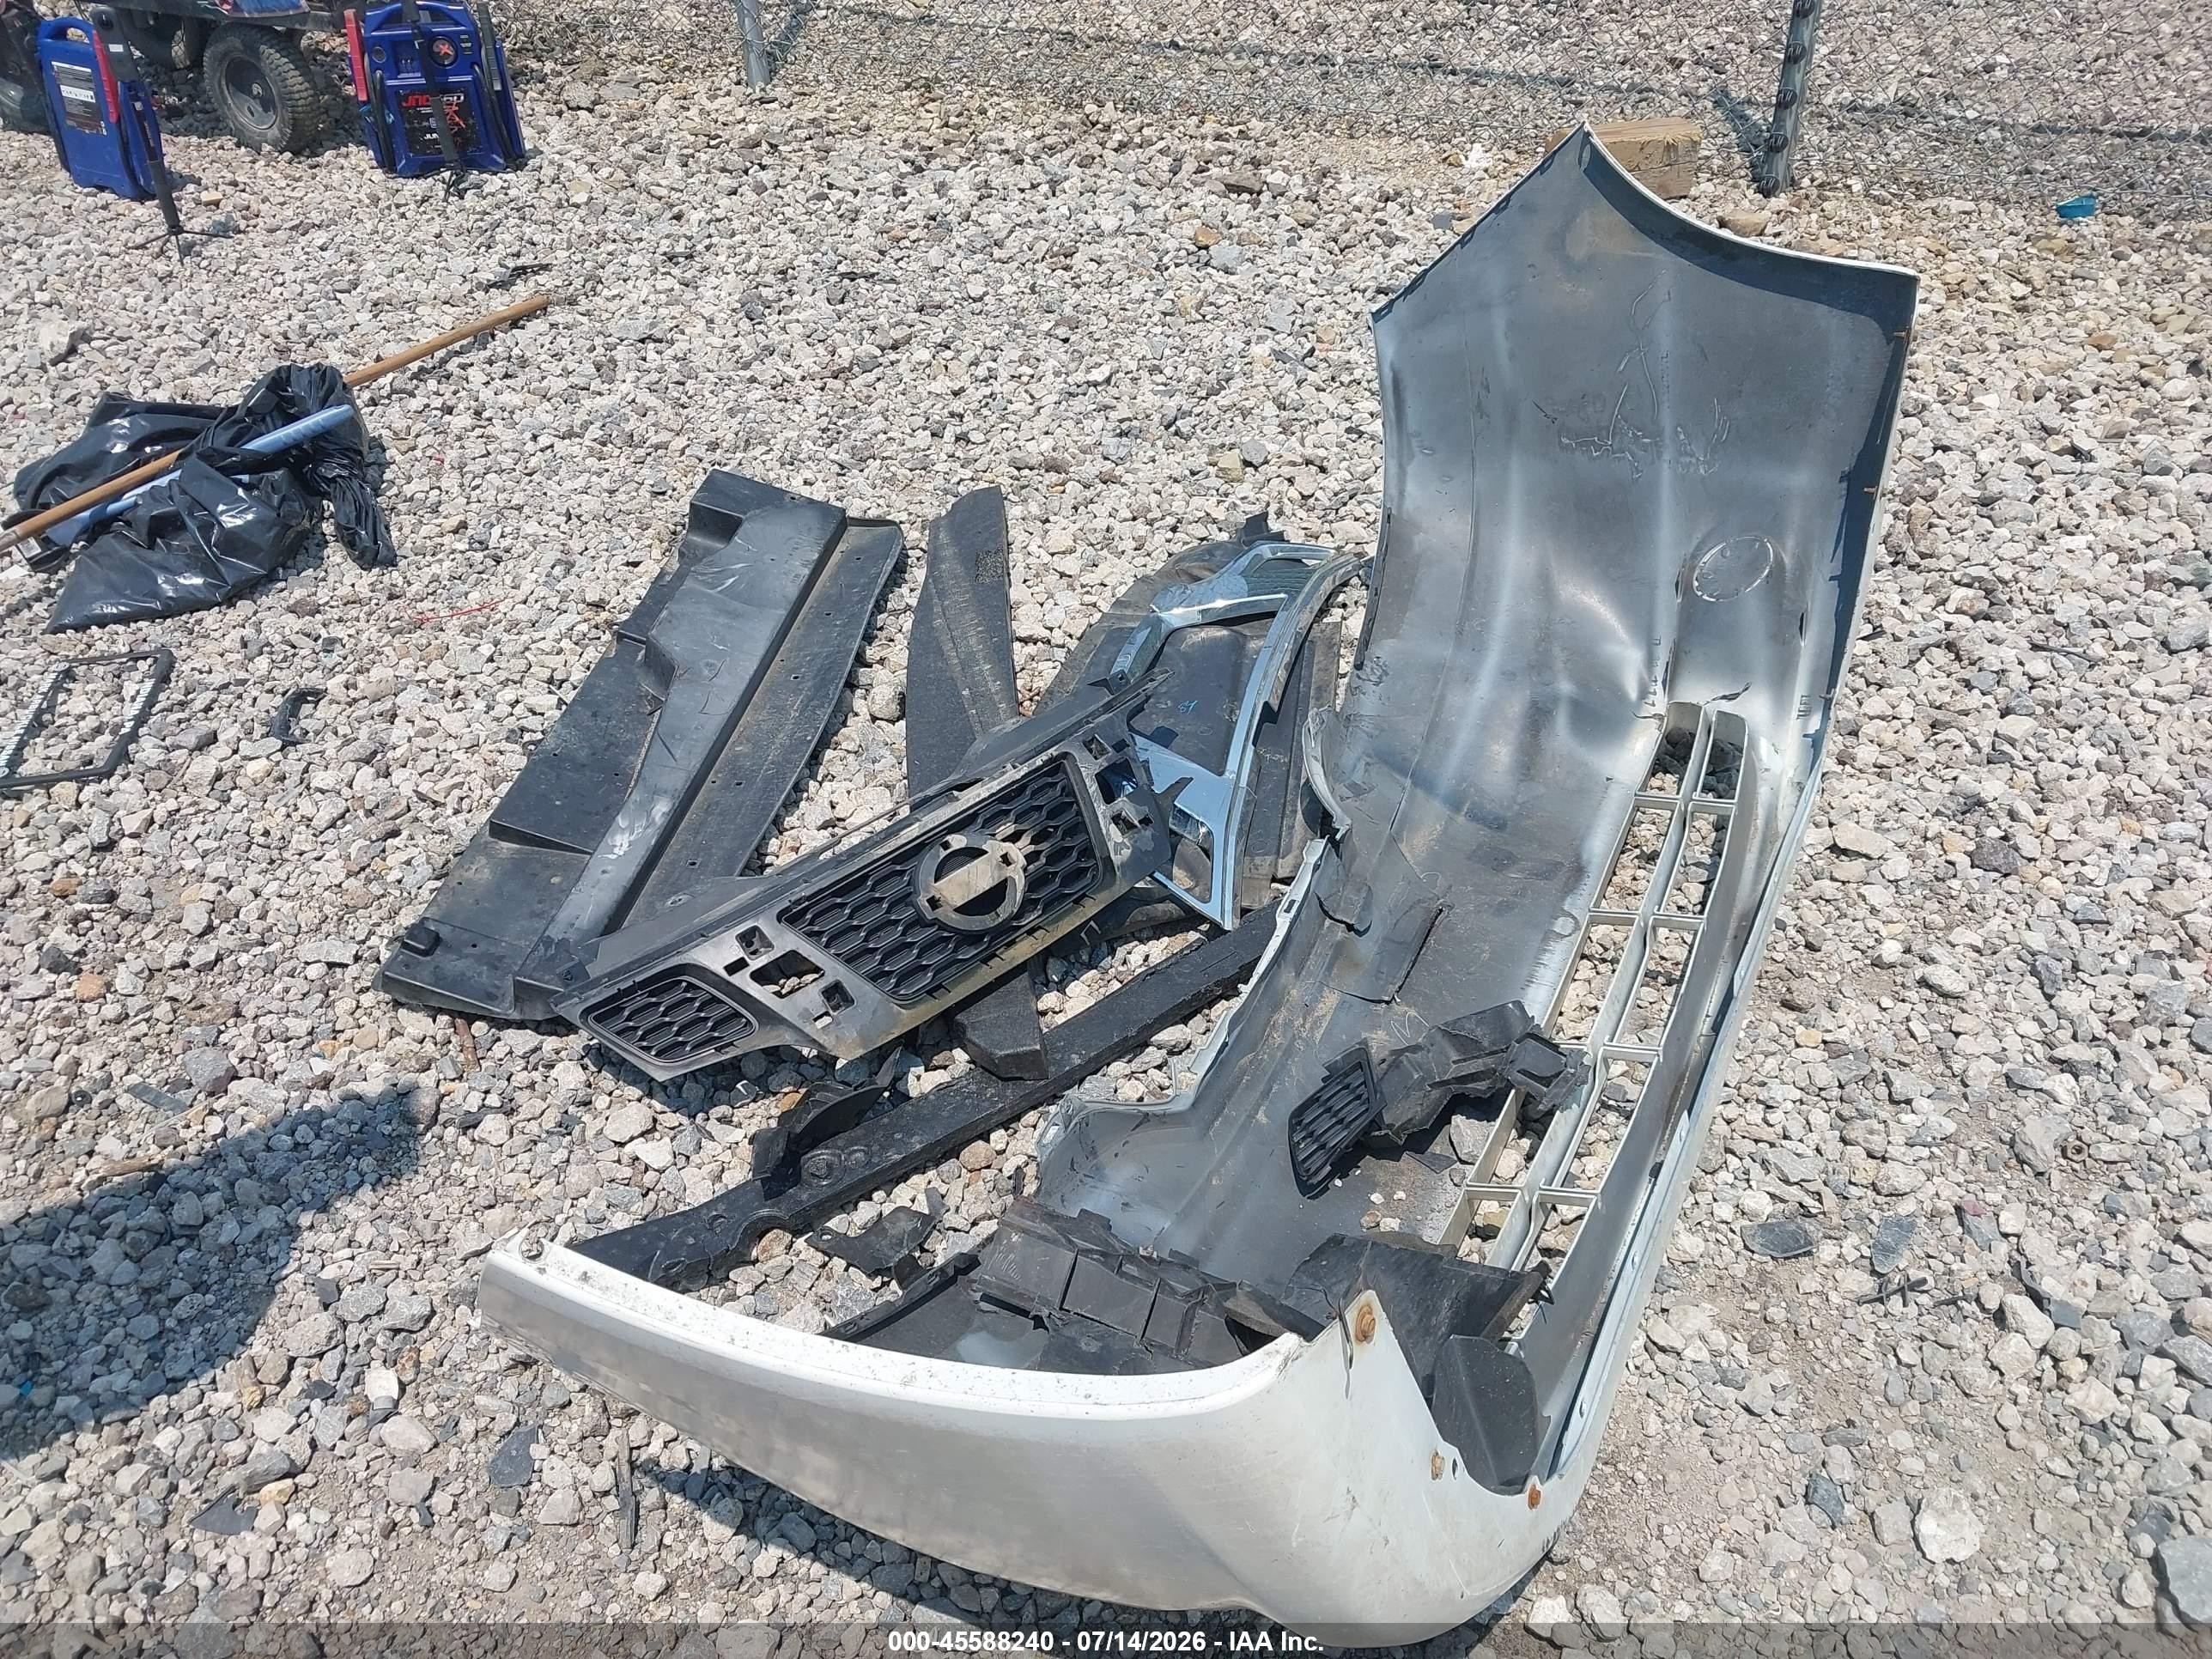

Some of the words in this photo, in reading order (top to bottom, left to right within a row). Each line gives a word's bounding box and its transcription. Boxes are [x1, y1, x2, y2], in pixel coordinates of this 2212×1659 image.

[38, 672, 58, 693] MARK
[14, 695, 45, 735] ARBUCKLE
[118, 720, 135, 735] PA
[0, 735, 21, 767] NISSAN
